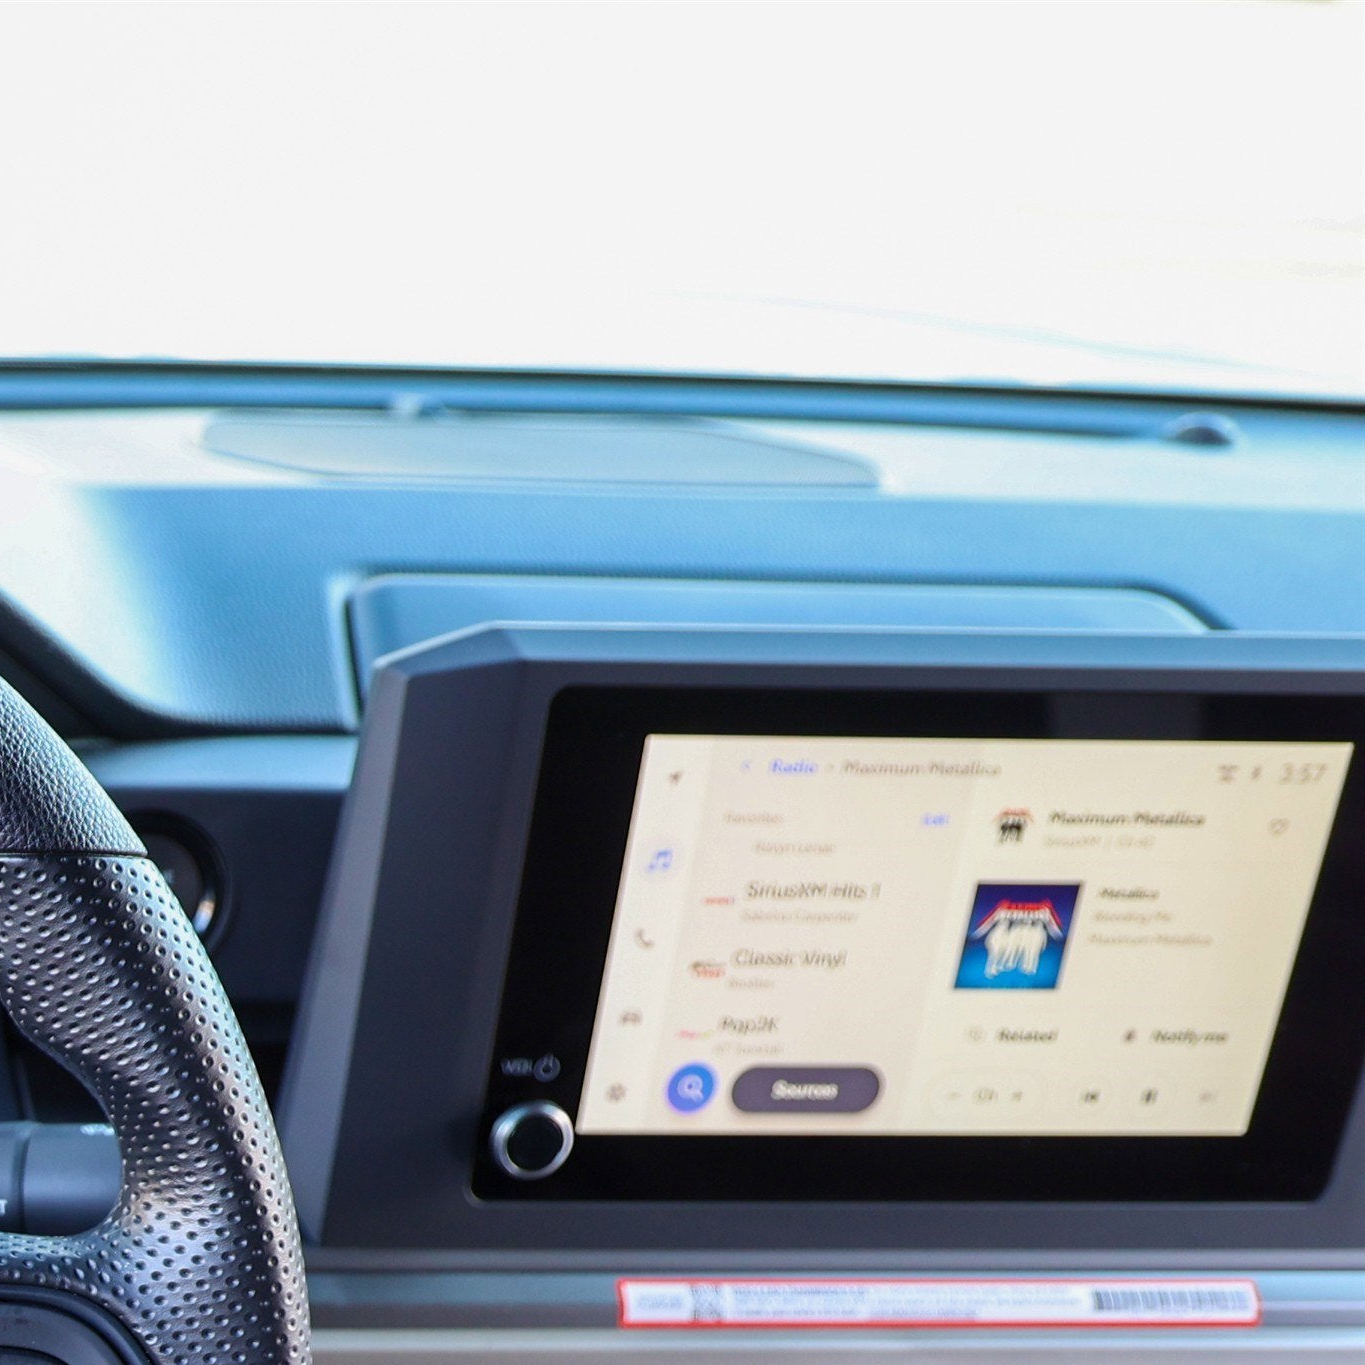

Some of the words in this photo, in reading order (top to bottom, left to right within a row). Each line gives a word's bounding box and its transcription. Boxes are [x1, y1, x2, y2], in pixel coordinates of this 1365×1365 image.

[769, 759, 819, 775] Radio
[1048, 811, 1126, 827] Maximum
[1133, 811, 1206, 827] Metallica
[746, 880, 828, 899] SiriusXM
[832, 881, 868, 899] Hits
[731, 949, 794, 968] Classic
[802, 950, 848, 970] Vinyl
[720, 1016, 779, 1034] Pop2K
[771, 1079, 838, 1100] Sources
